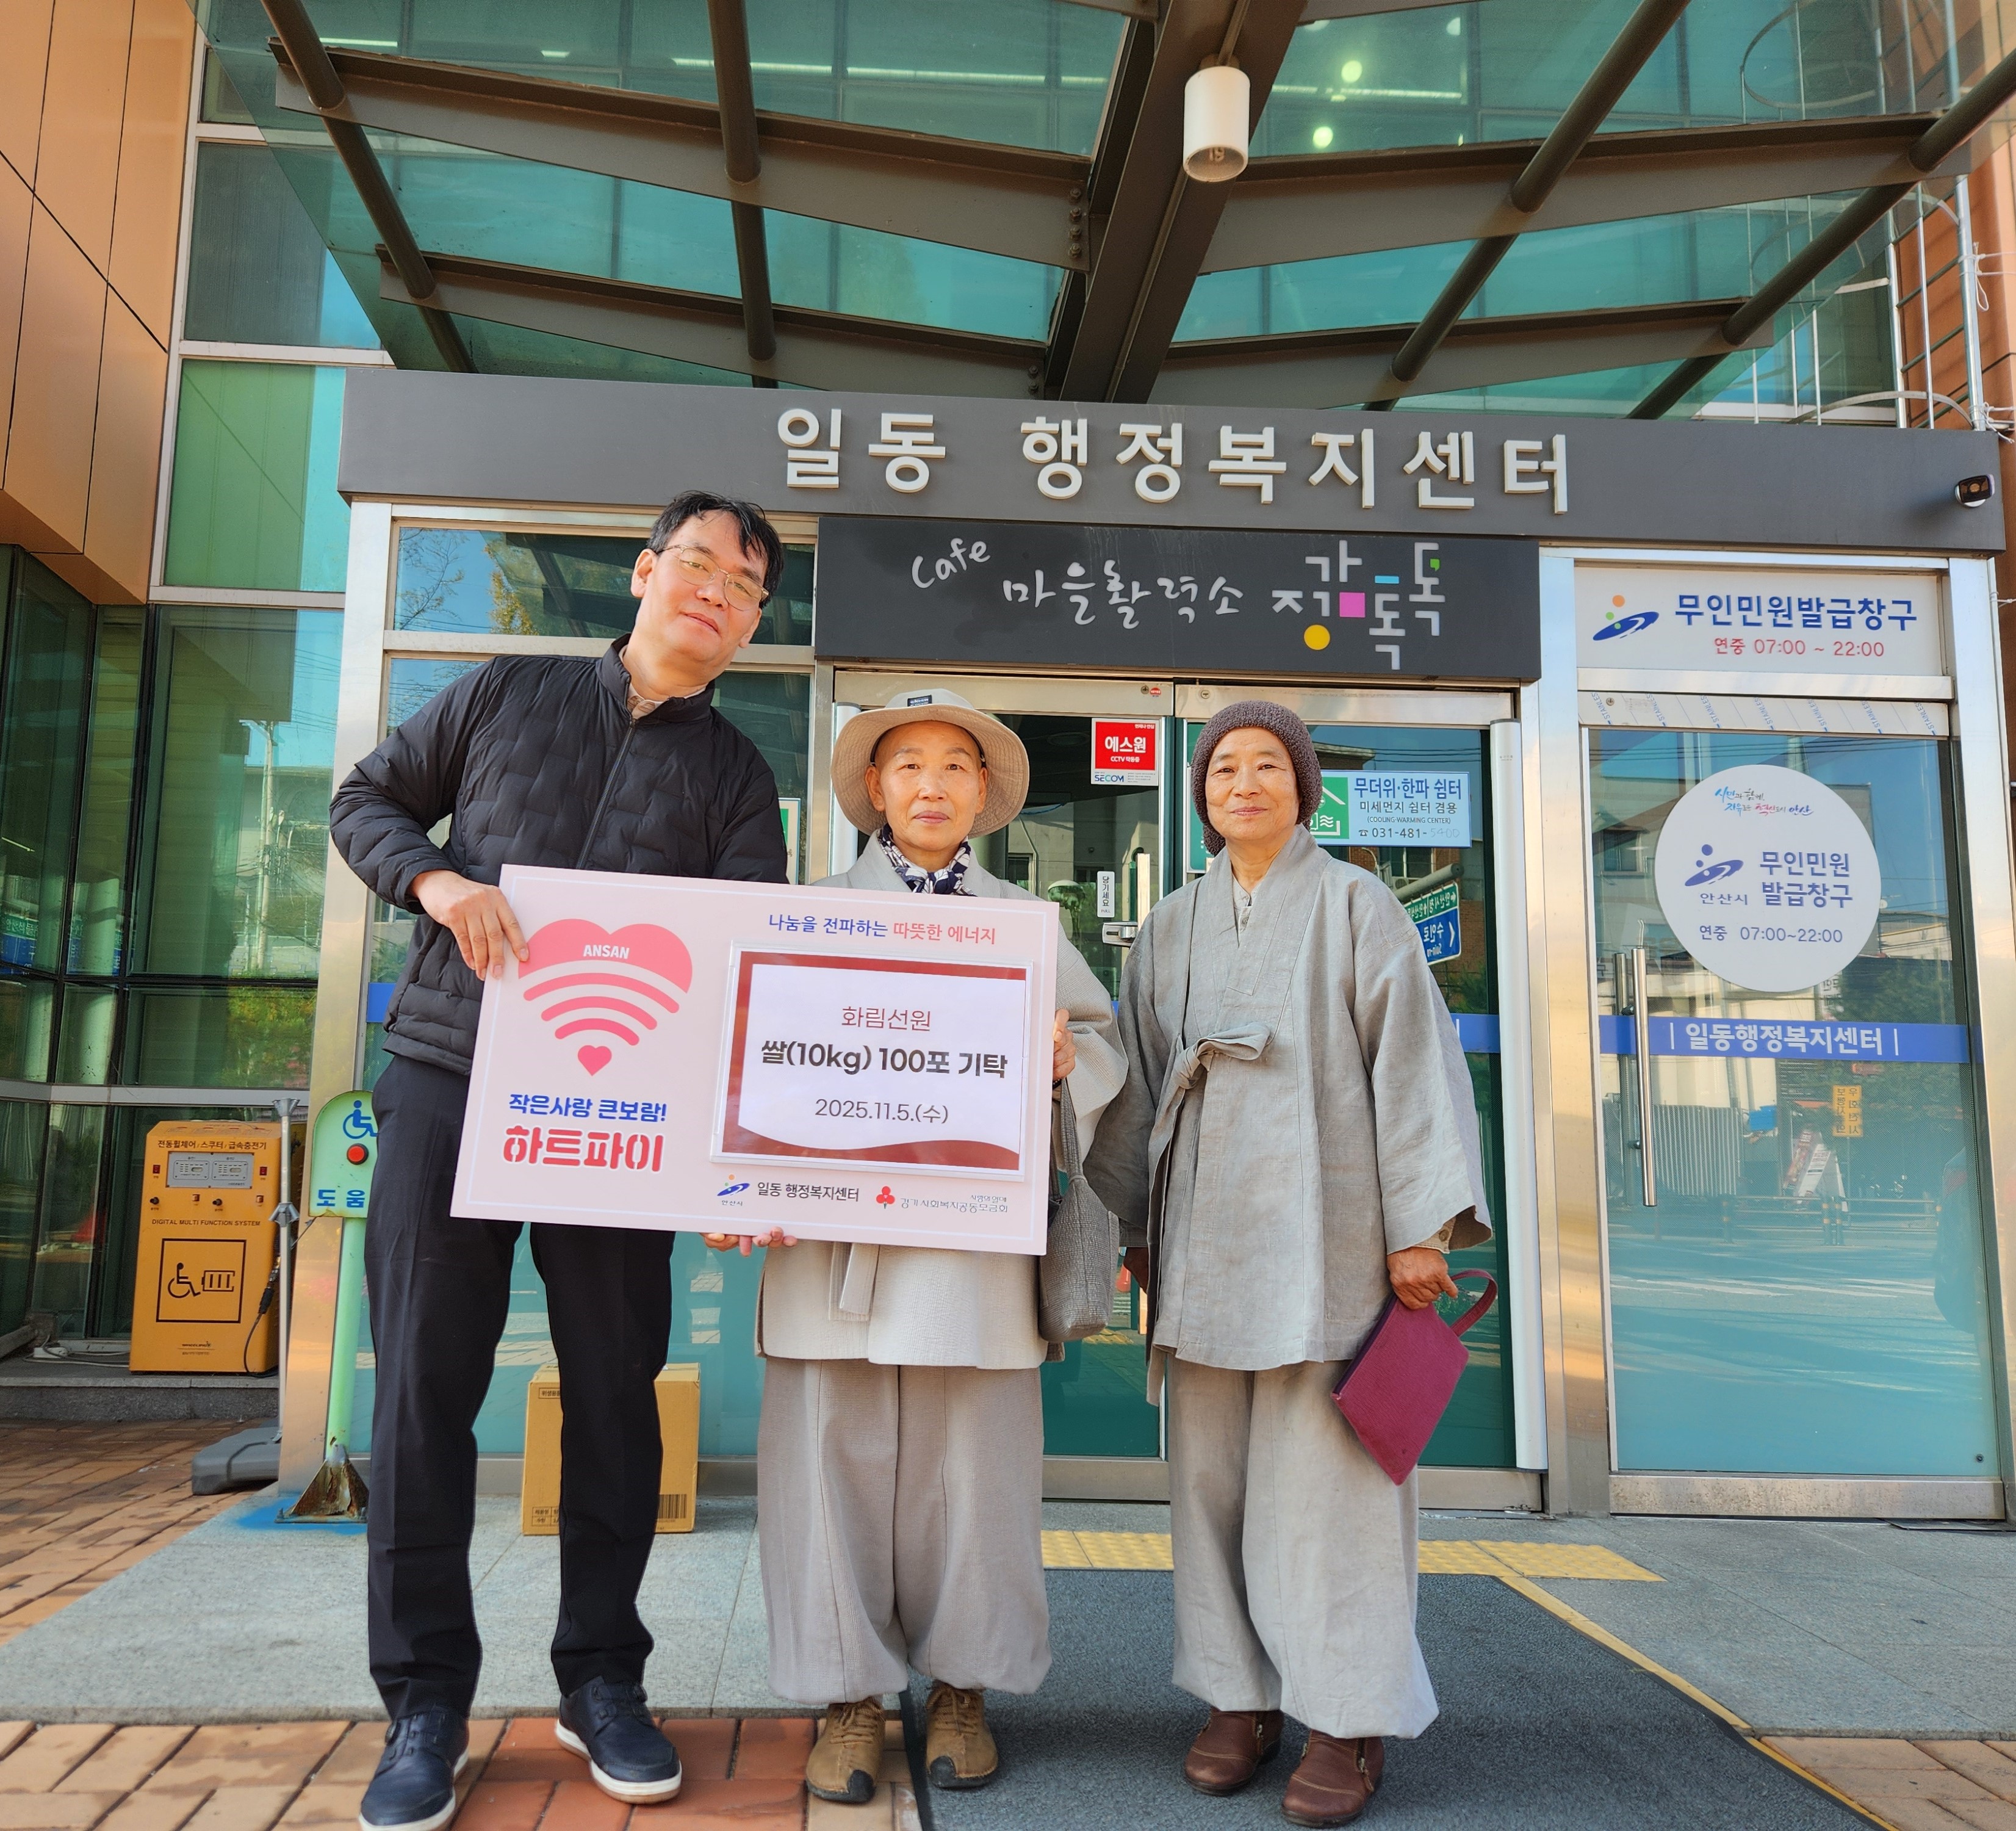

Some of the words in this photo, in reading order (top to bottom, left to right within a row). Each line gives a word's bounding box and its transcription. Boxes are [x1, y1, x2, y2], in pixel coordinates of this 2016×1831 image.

[777, 408, 946, 493] 일동
[1020, 416, 1568, 515] 행정복지센터
[912, 538, 990, 588] Cafe
[1676, 594, 1917, 631] 무인민원발급창구
[1715, 638, 1745, 655] 연중
[1754, 639, 1805, 655] 07:00
[1834, 641, 1884, 657] 22:00
[1104, 736, 1147, 753] 에스원
[1354, 778, 1430, 799] 무더위·한파
[1434, 779, 1461, 800] 쉼터
[1359, 801, 1404, 814] 미세먼지
[1408, 801, 1431, 814] 쉼터
[1435, 802, 1458, 814] 겸용
[1789, 804, 1814, 816] 안산
[1760, 851, 1849, 878] 무인민원
[1700, 893, 1748, 905] 안산시
[1762, 881, 1853, 908] 발급창구
[769, 914, 818, 933] 나눔을
[823, 917, 888, 937] 전파하는
[893, 922, 943, 941] 따뜻한
[948, 925, 996, 945] 에너지
[1699, 925, 1727, 941] 연중
[1740, 926, 1843, 943] 07:00~22:00
[583, 944, 630, 959] ANSAN
[841, 1006, 931, 1031] 화림선원
[1685, 1022, 1884, 1057] 일동행정복지센터
[761, 1040, 872, 1075] 쌀(10kg)
[879, 1047, 951, 1074] 100포
[958, 1053, 1008, 1078] 기탁
[509, 1094, 593, 1119] 작은사랑
[598, 1099, 667, 1122] 큰보람!
[815, 1098, 949, 1124] 2025.11.5.(수)
[228, 1141, 267, 1150] 급속충전기
[503, 1125, 664, 1172] 하트파이
[757, 1182, 782, 1197] 일동
[785, 1183, 860, 1202] 행정복지센터
